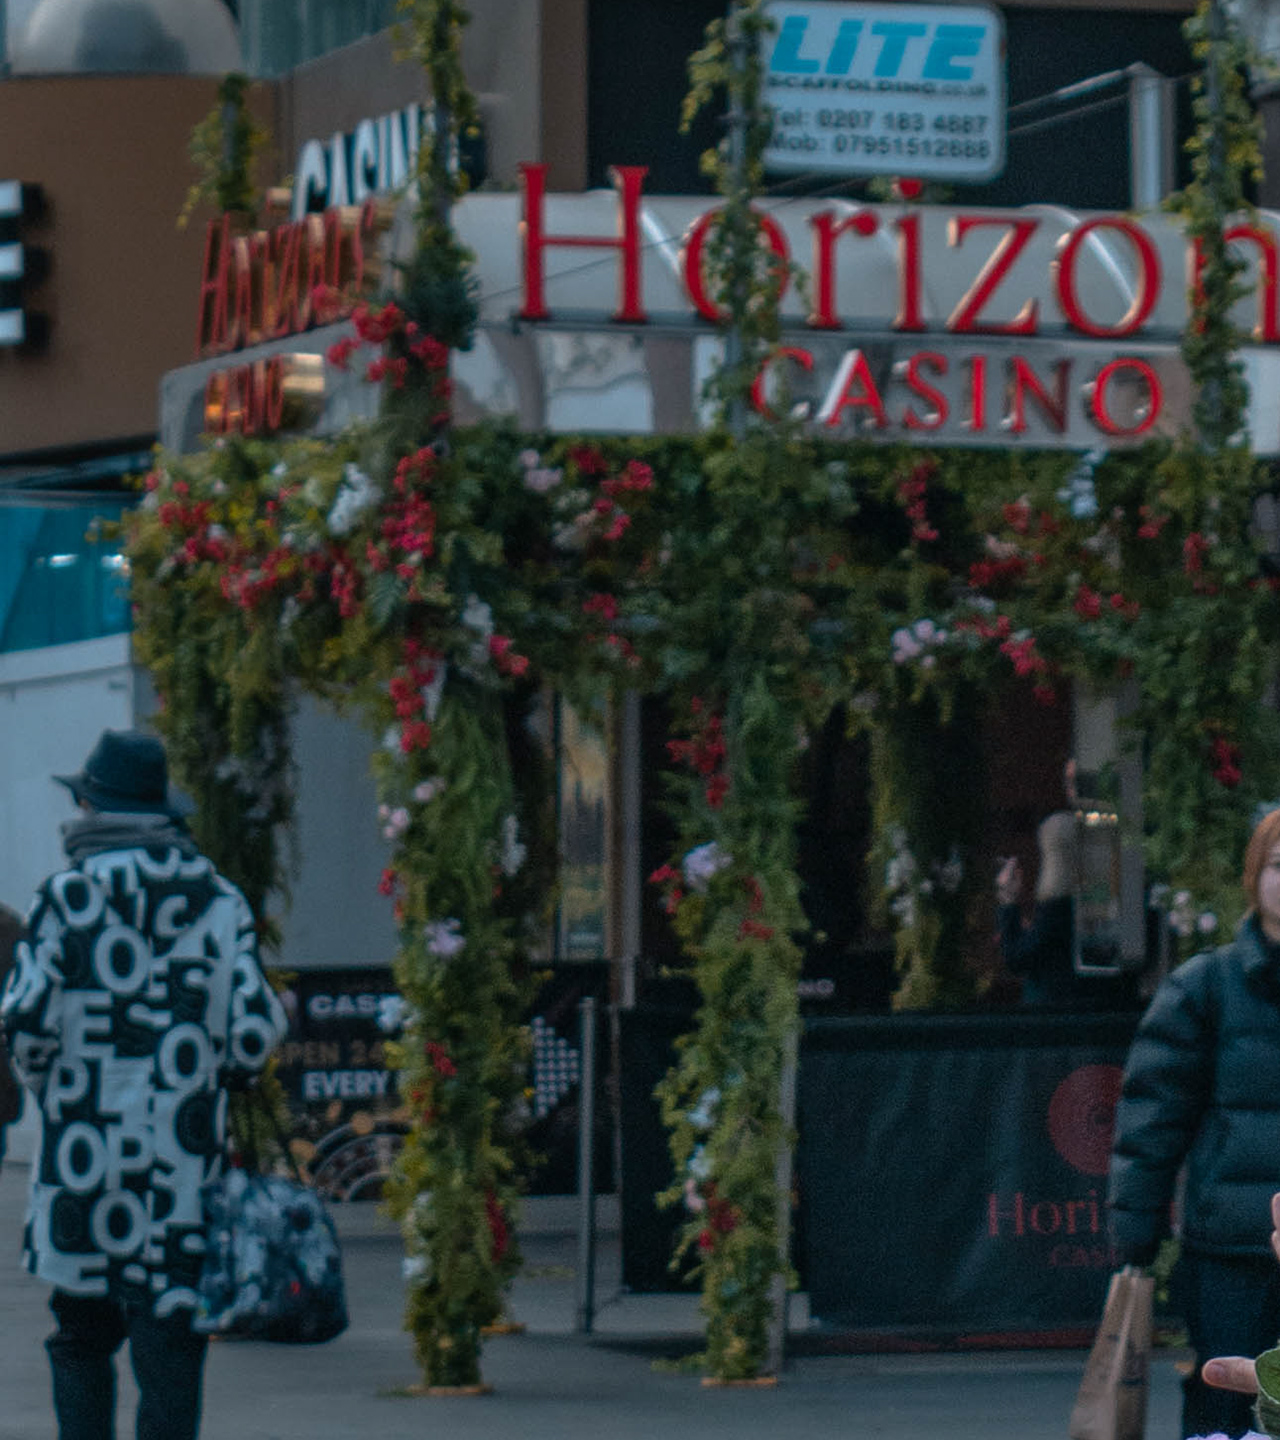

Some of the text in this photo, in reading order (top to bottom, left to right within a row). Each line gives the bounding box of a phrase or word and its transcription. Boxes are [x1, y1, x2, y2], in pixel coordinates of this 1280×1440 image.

[769, 15, 988, 81] LITE
[817, 108, 875, 130] 0207
[751, 347, 1163, 436] CASINO
[303, 1070, 390, 1099] EVERY
